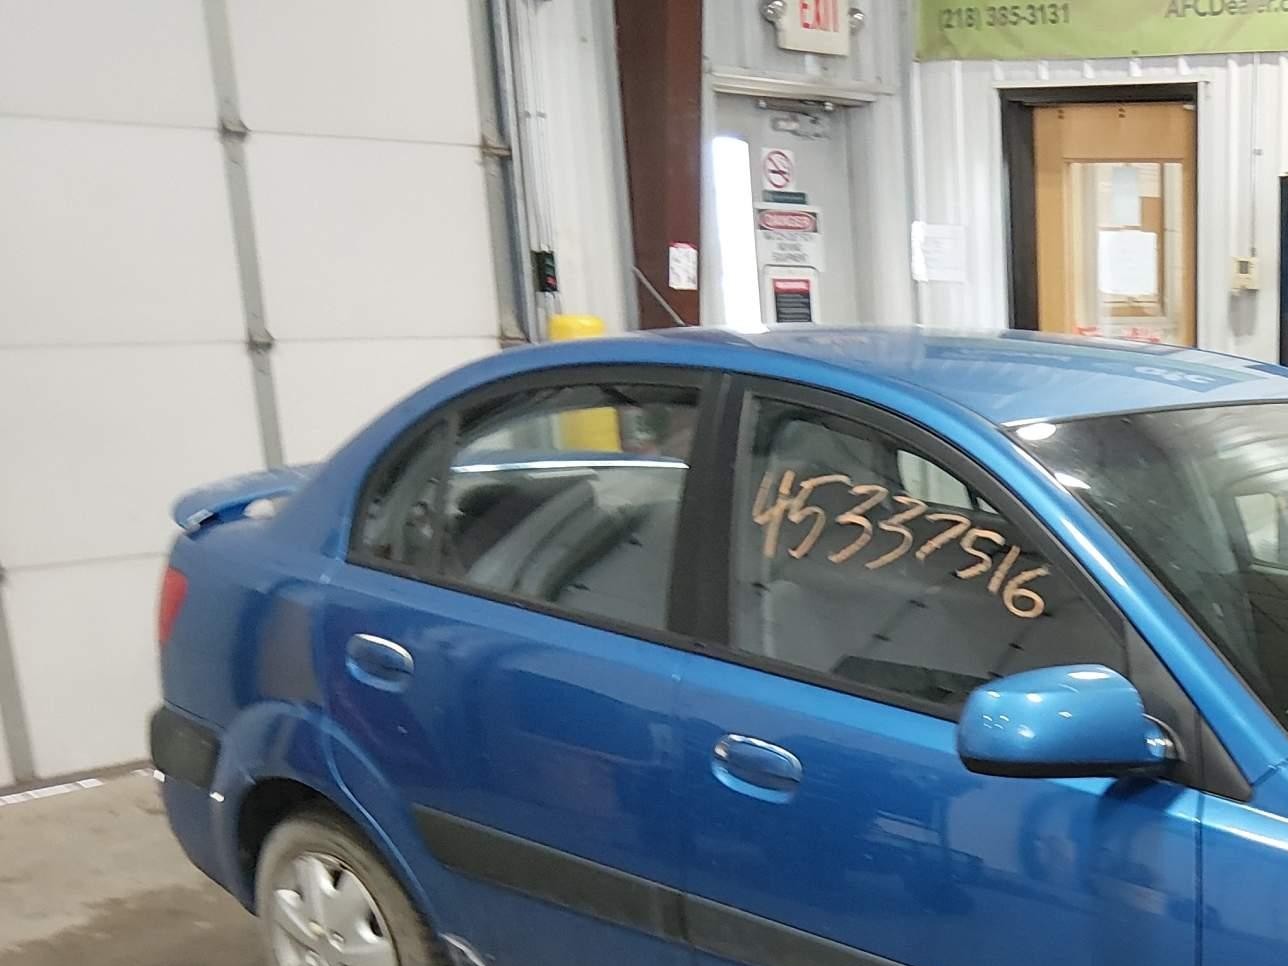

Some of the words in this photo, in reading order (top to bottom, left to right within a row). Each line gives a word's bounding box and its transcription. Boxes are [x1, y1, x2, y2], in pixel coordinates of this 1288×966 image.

[939, 7, 981, 31] (218)
[986, 3, 1070, 26] 385-3131
[752, 469, 1050, 618] 45337516
